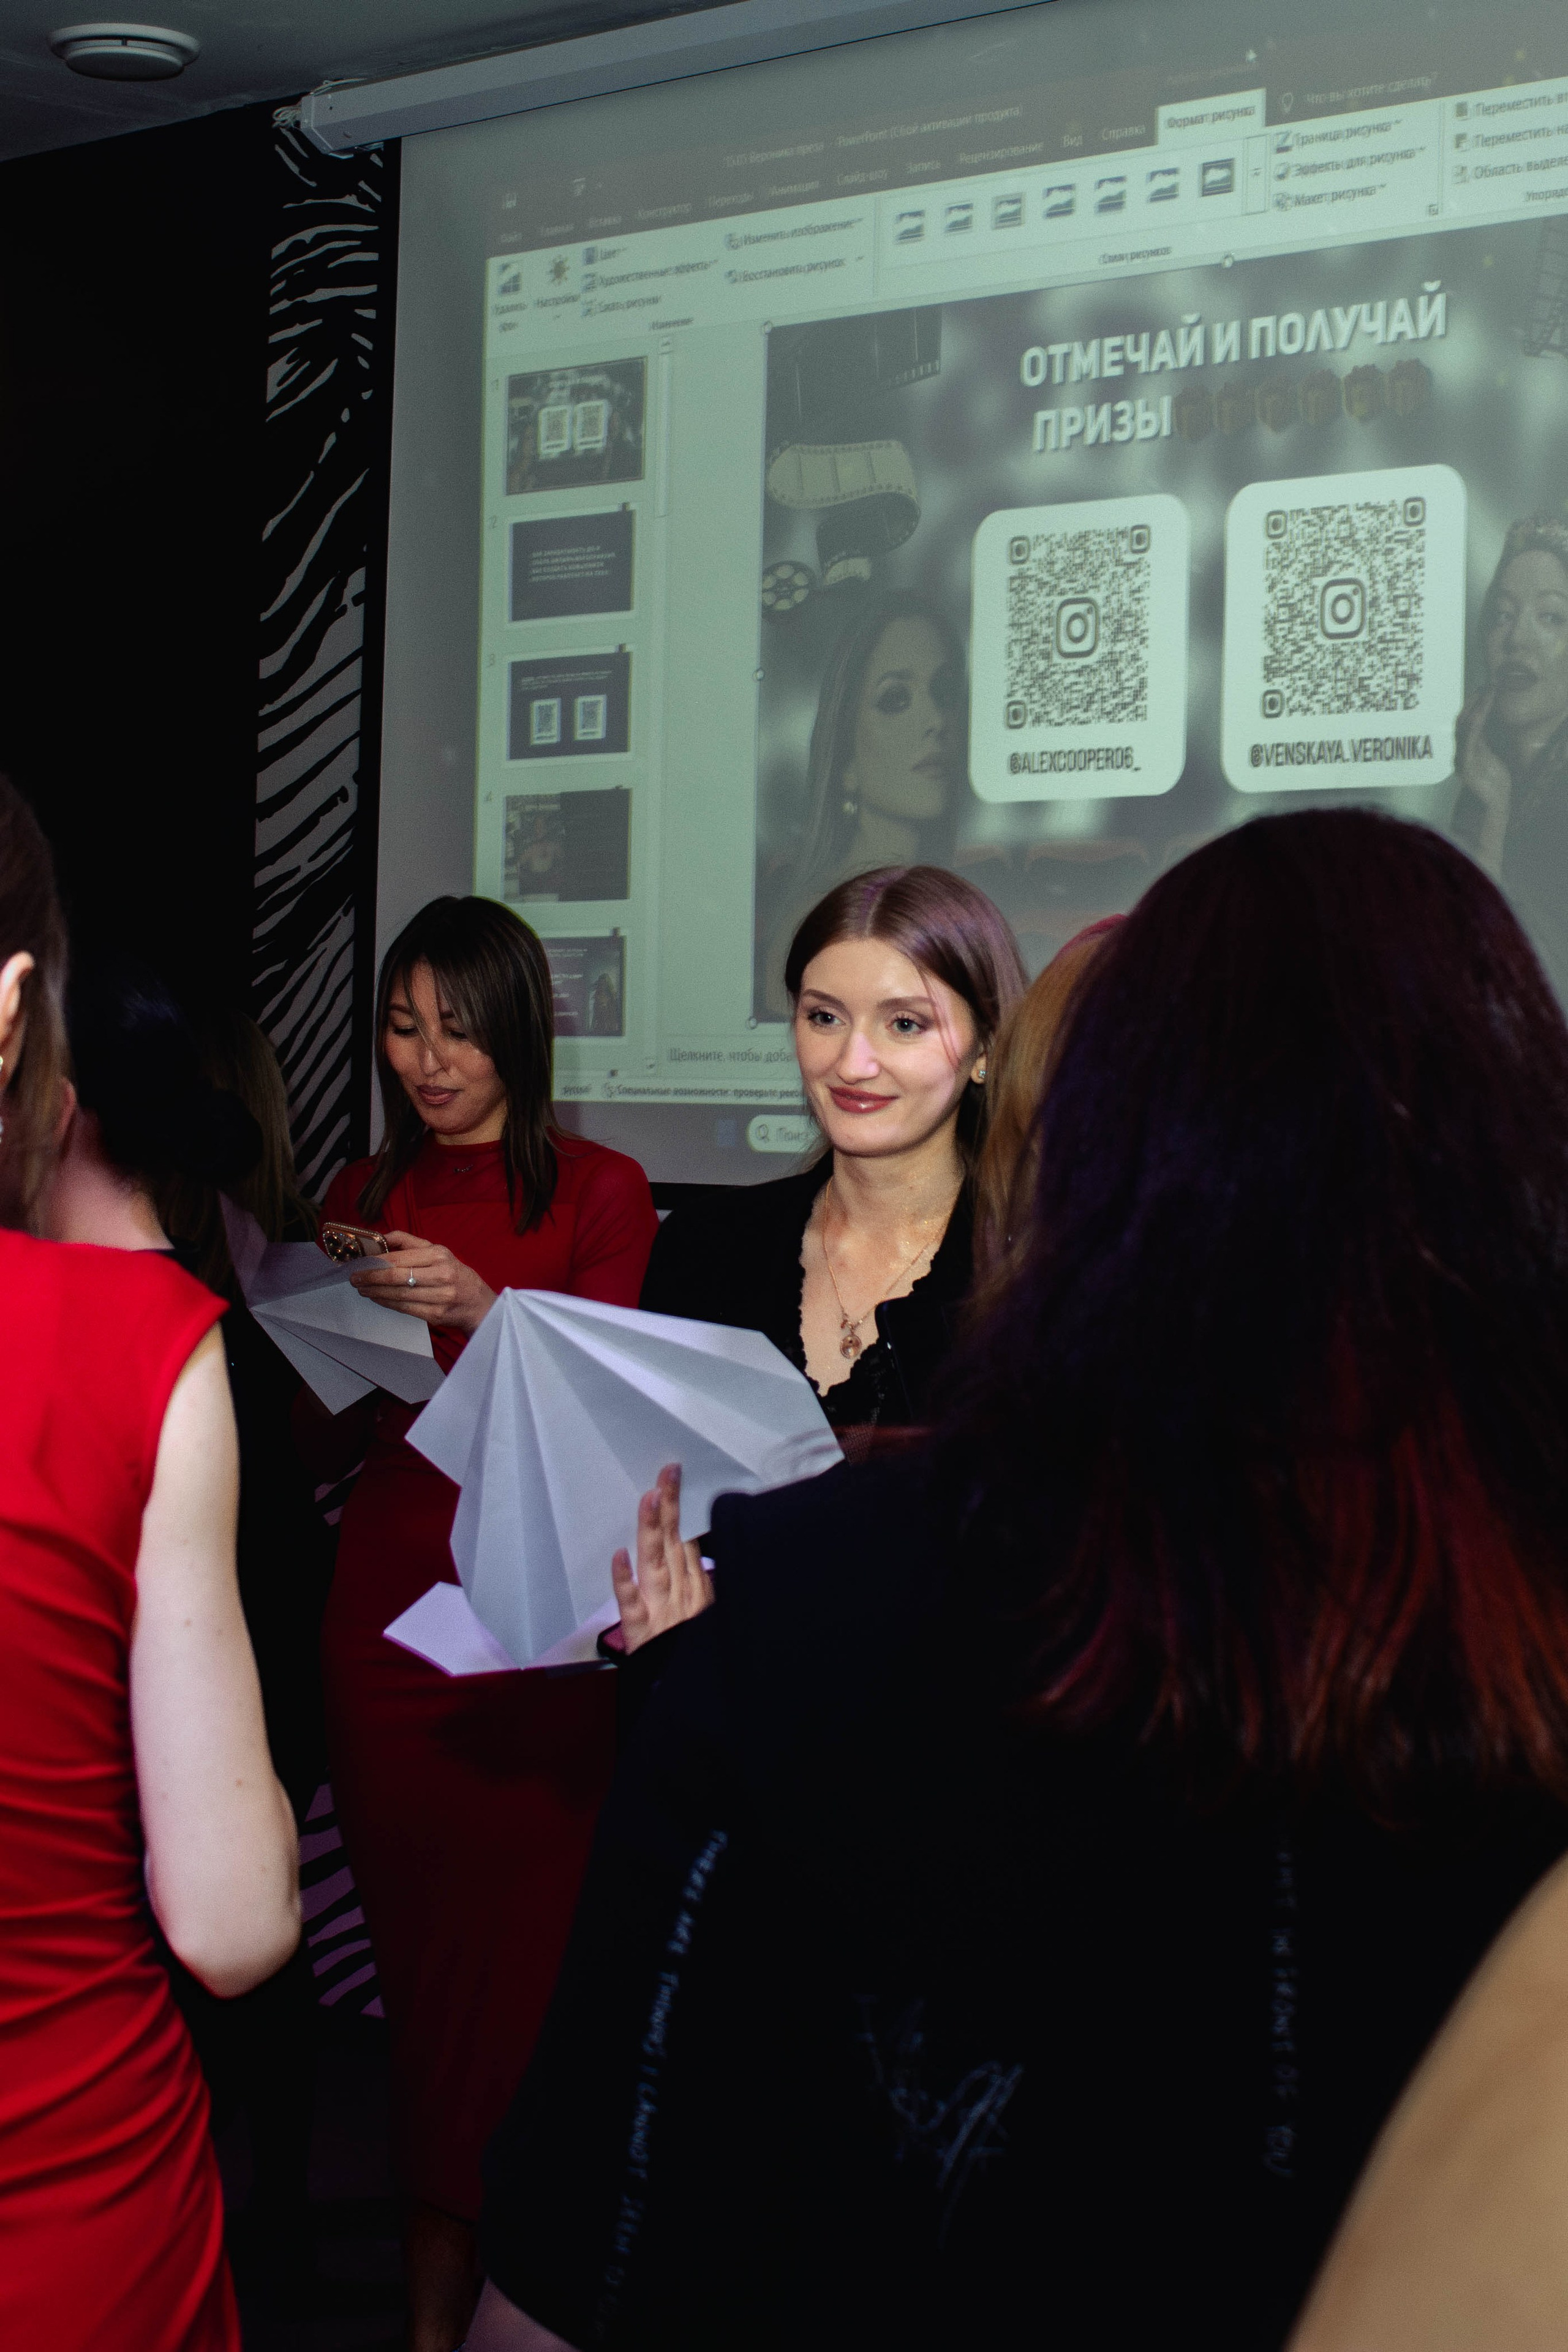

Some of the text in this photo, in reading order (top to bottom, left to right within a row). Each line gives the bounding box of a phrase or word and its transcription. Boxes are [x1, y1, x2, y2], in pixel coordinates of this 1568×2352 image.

[1476, 96, 1553, 116] Переместить
[1061, 134, 1083, 147] Вид
[1101, 124, 1146, 141] Справка
[1166, 112, 1208, 130] Формат
[1212, 105, 1256, 124] рисунка
[1345, 123, 1391, 140] рисунка
[1475, 126, 1553, 148] Переместить
[1369, 149, 1416, 166] рисунка
[1474, 163, 1523, 180] Область
[1294, 185, 1376, 206] Макет рисунка
[1021, 280, 1447, 387] ОТМЕЧАЙ И ПОЛУЧАЙ
[1032, 396, 1172, 452] ПРИЗЫ
[1009, 746, 1140, 774] @ALEXCOOPER06_
[670, 1048, 726, 1063] Щелкните,
[729, 1047, 762, 1061] чтобы
[625, 2082, 660, 2184] CANNOT
